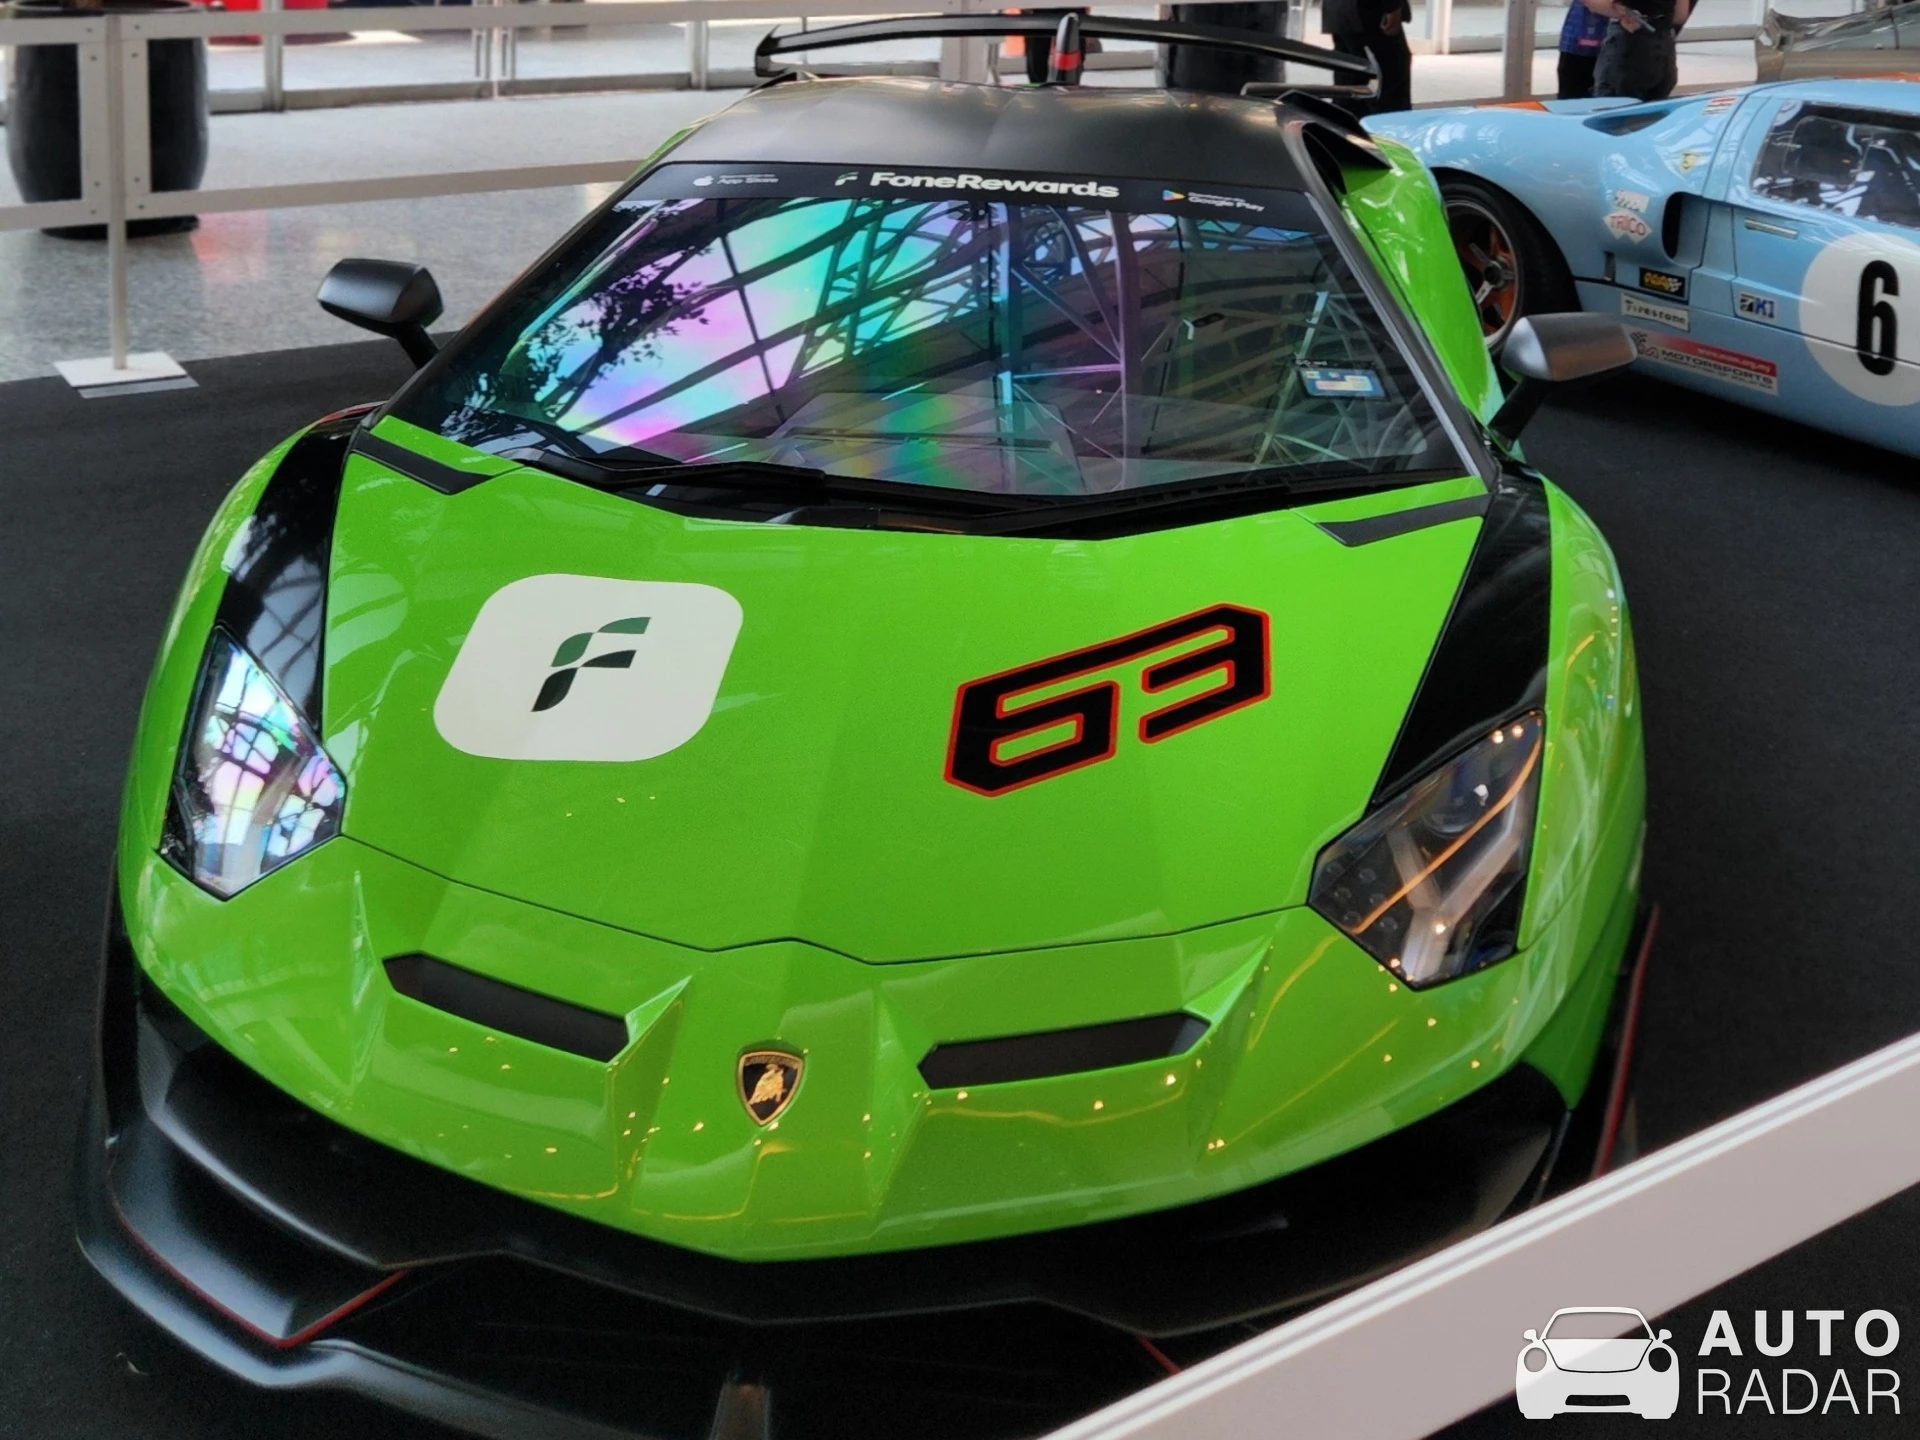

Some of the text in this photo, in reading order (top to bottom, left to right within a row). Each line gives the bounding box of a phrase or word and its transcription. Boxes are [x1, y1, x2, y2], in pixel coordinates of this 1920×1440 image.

[869, 171, 1120, 198] FoneRewards
[1624, 299, 1687, 324] Firestone
[1856, 259, 1900, 376] 6
[1660, 349, 1774, 385] MOTORSPORTS
[943, 602, 1271, 798] 63
